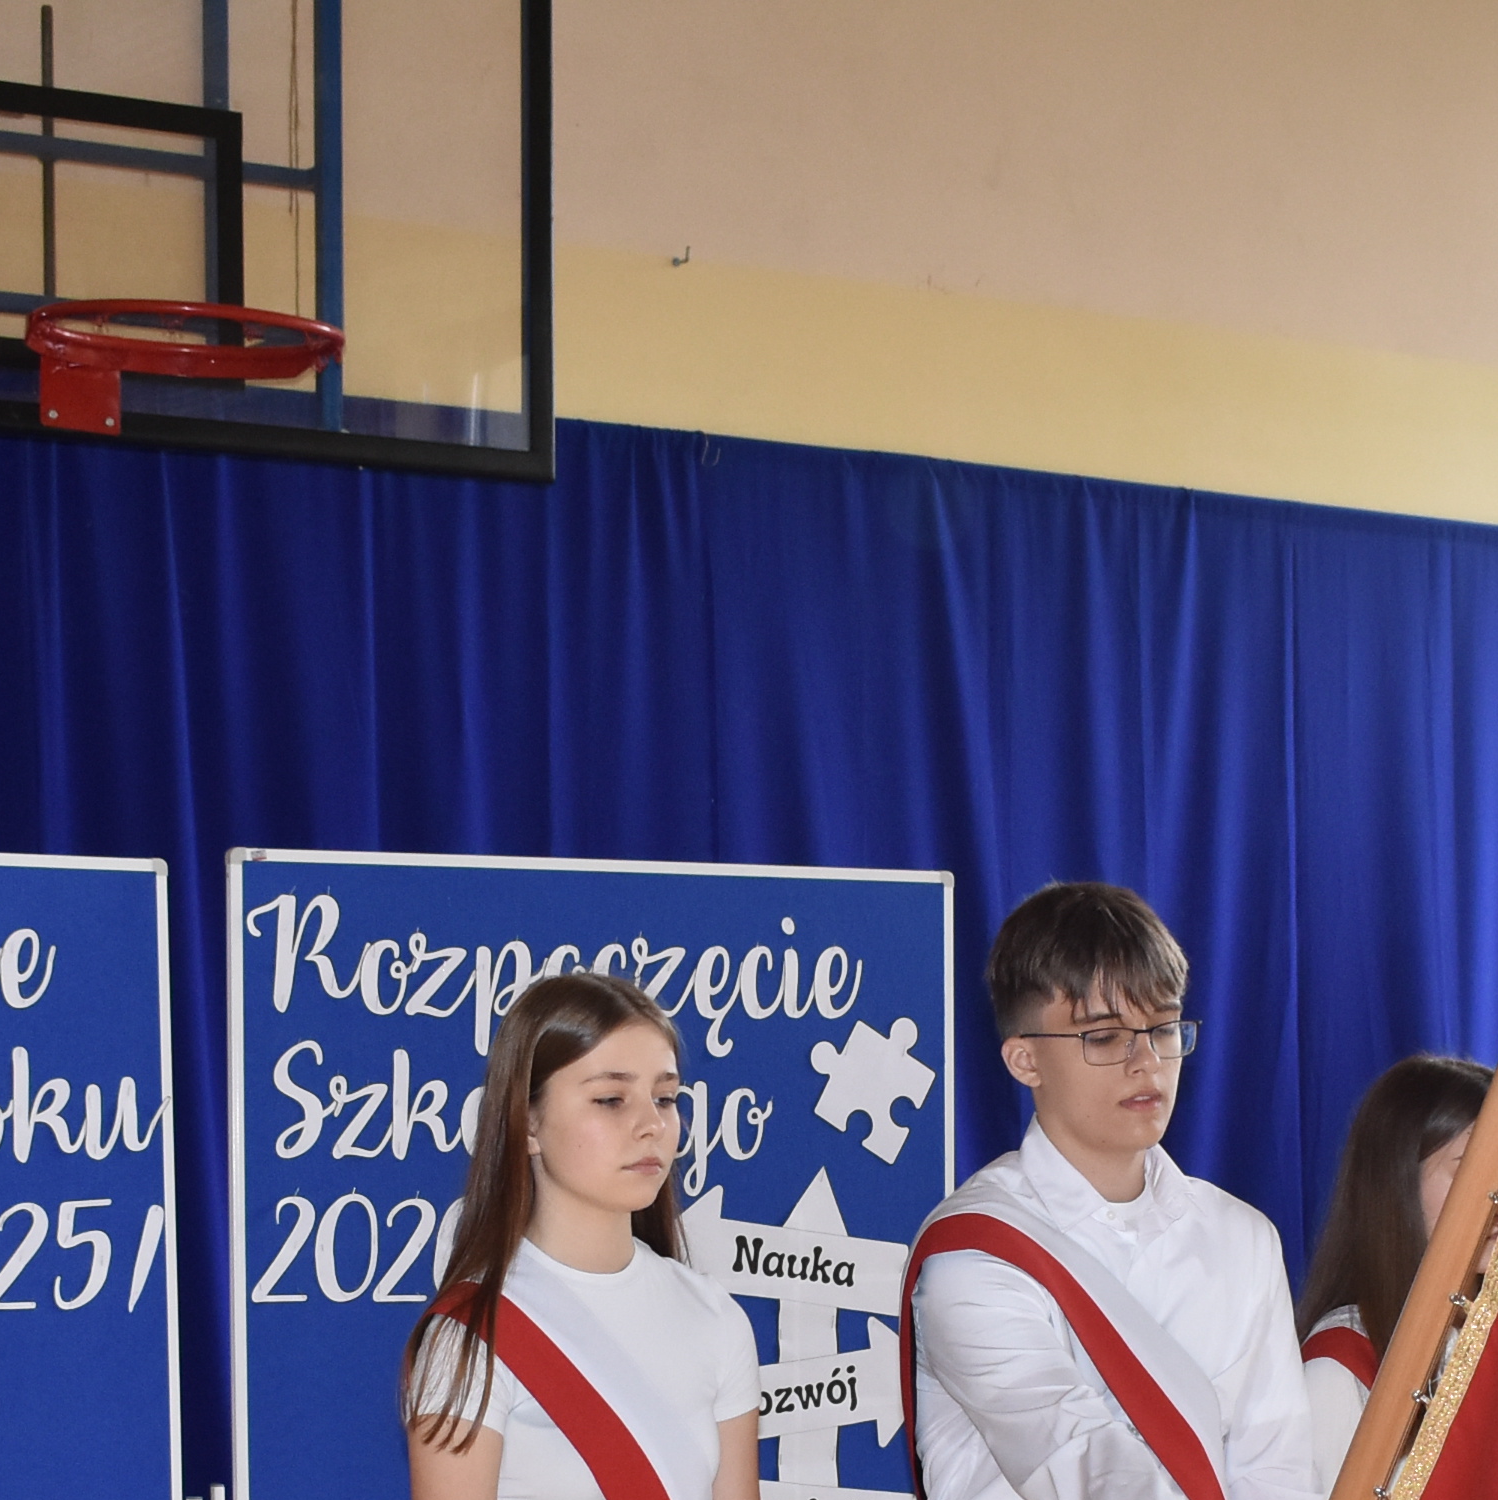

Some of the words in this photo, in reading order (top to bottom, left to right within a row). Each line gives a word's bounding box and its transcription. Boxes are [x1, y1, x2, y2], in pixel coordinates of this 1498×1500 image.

[273, 1039, 775, 1197] Szkgo
[732, 1235, 855, 1287] Nauka
[759, 1365, 857, 1416] ozwój
